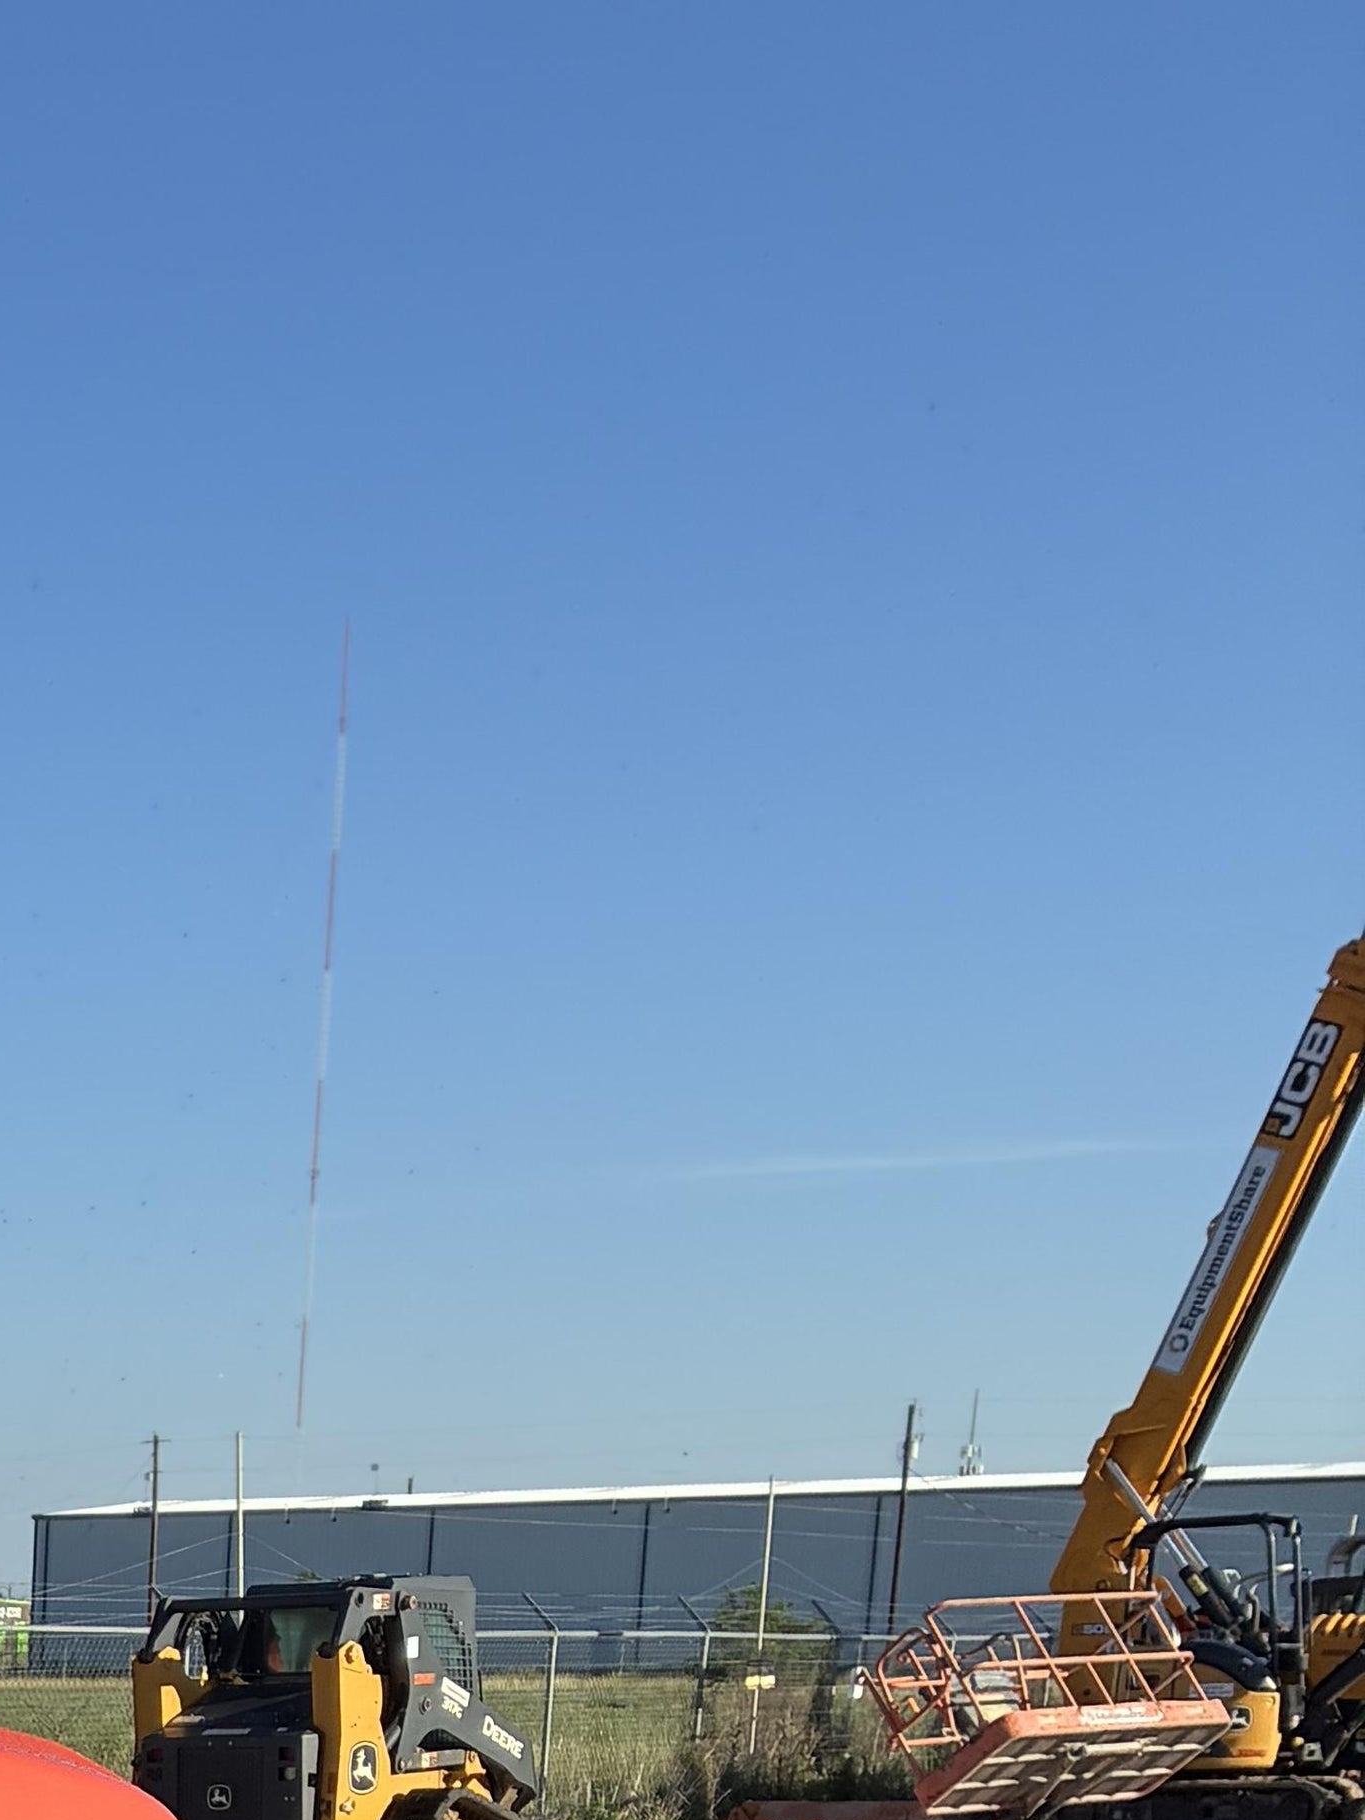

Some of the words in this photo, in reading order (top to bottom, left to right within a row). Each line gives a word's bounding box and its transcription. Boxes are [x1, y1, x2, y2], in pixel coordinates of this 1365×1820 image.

[1272, 1021, 1339, 1138] JCB
[1178, 1164, 1267, 1332] EquipmentShare
[482, 1714, 525, 1760] DEERE
